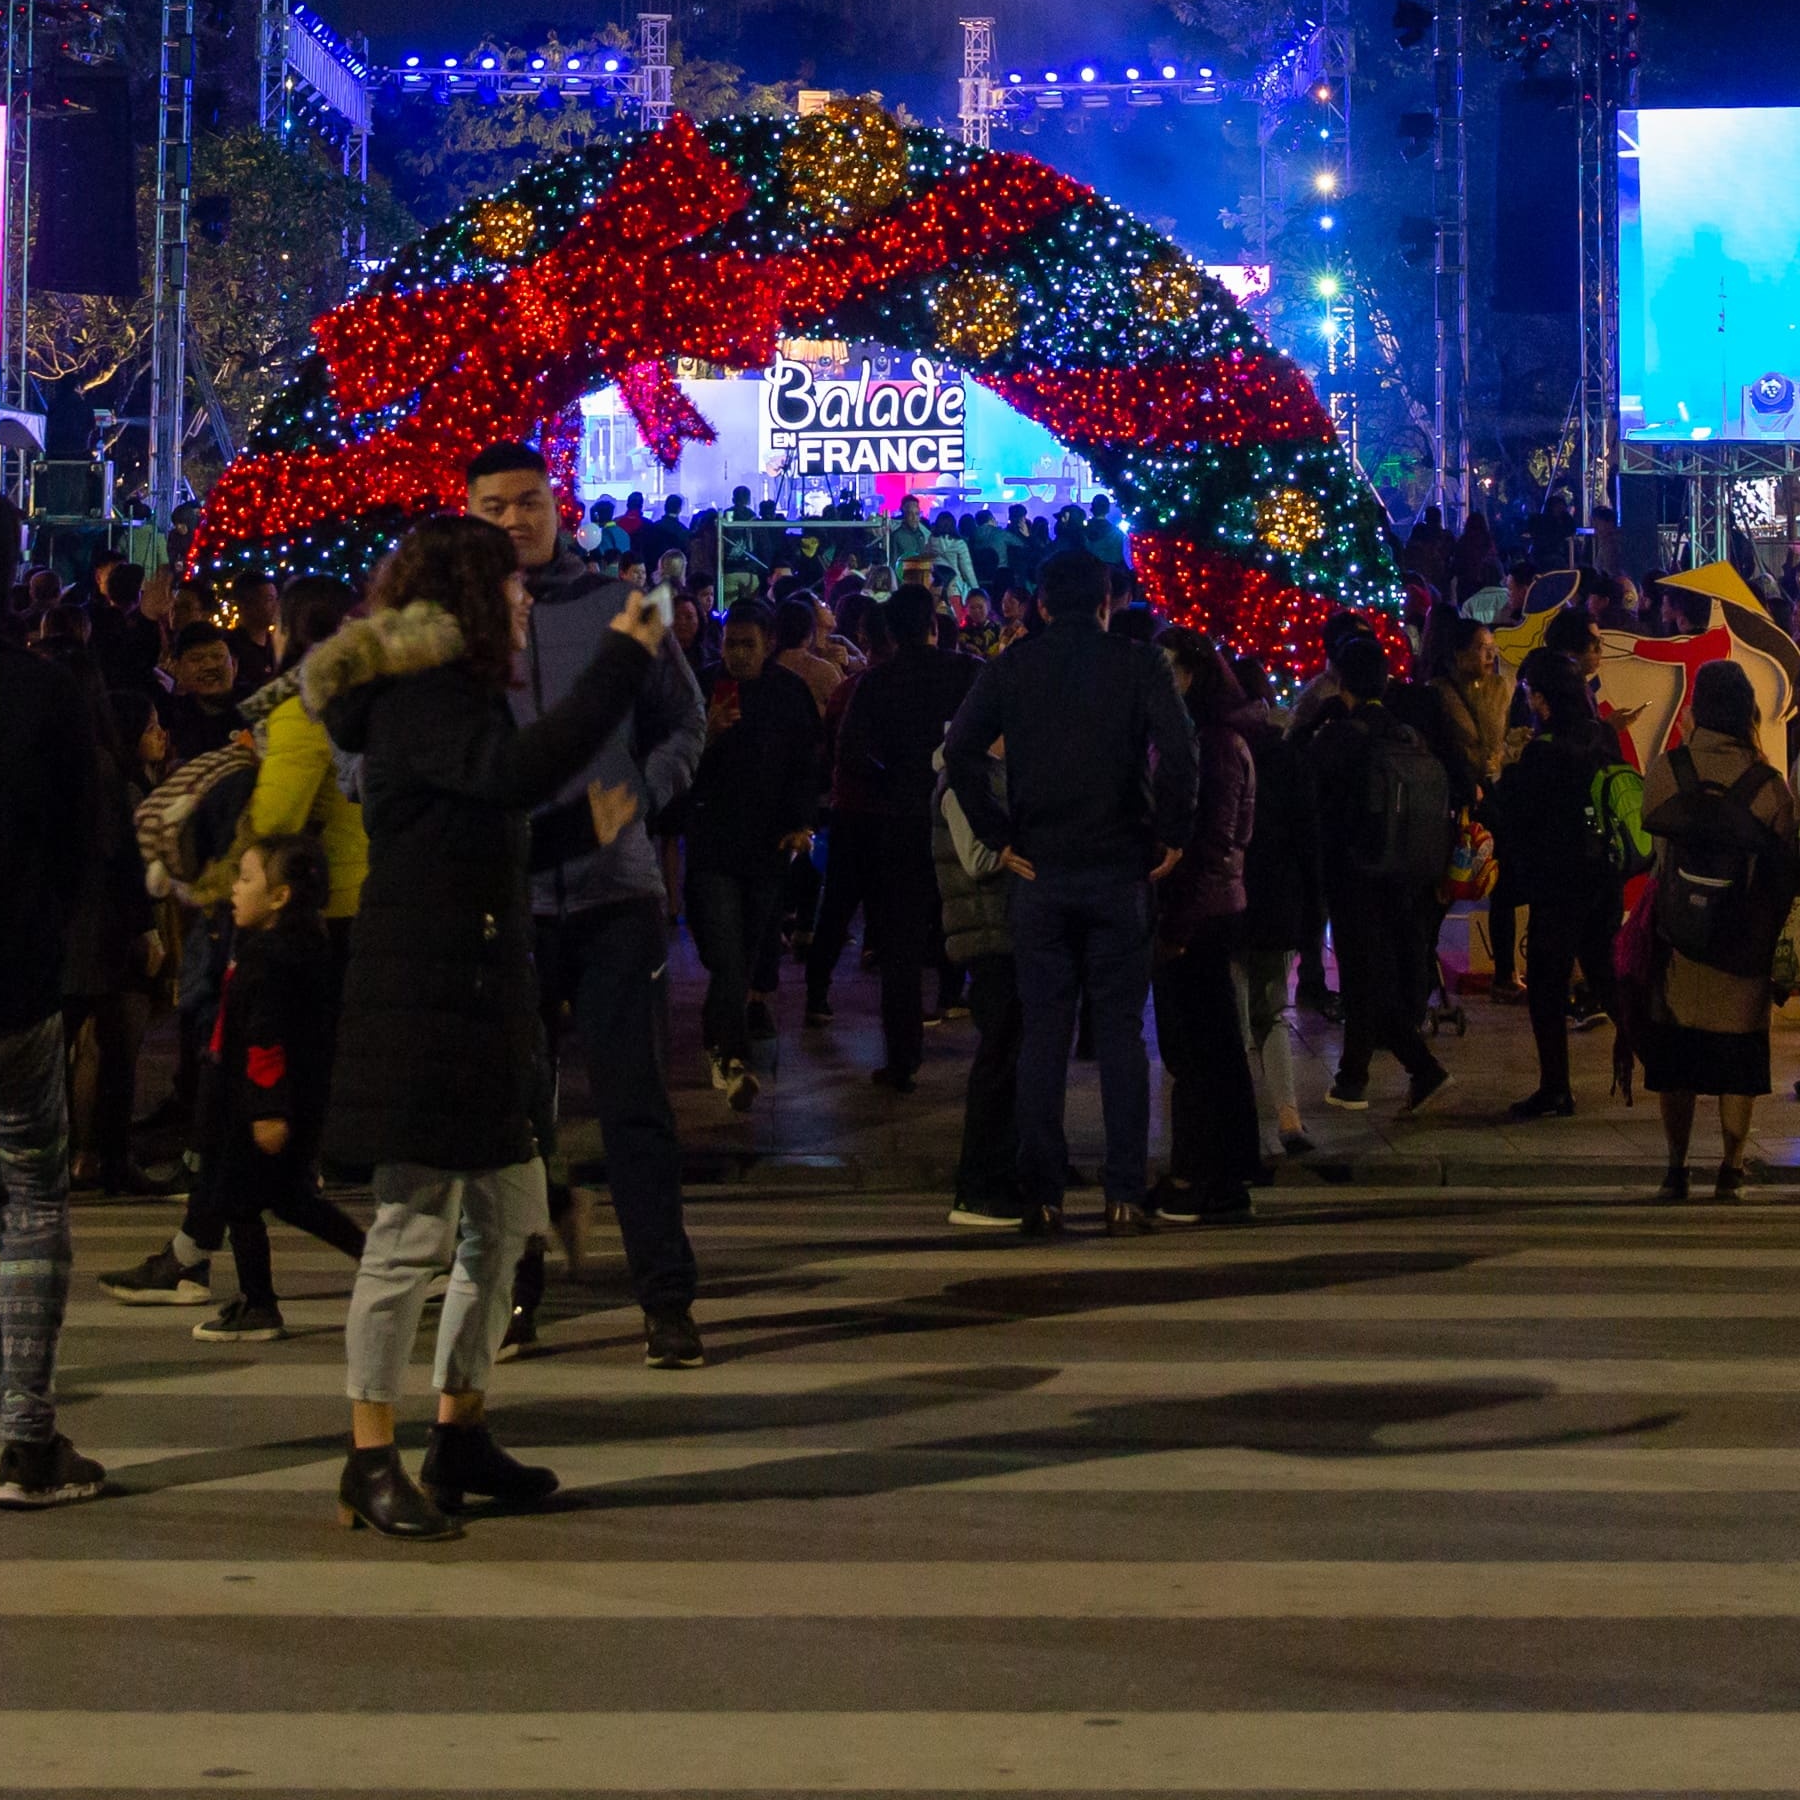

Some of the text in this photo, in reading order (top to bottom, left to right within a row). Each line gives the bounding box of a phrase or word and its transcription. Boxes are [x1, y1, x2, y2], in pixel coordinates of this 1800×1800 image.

[763, 351, 964, 430] Balade
[773, 432, 797, 448] EN
[798, 437, 964, 473] FRANCE
